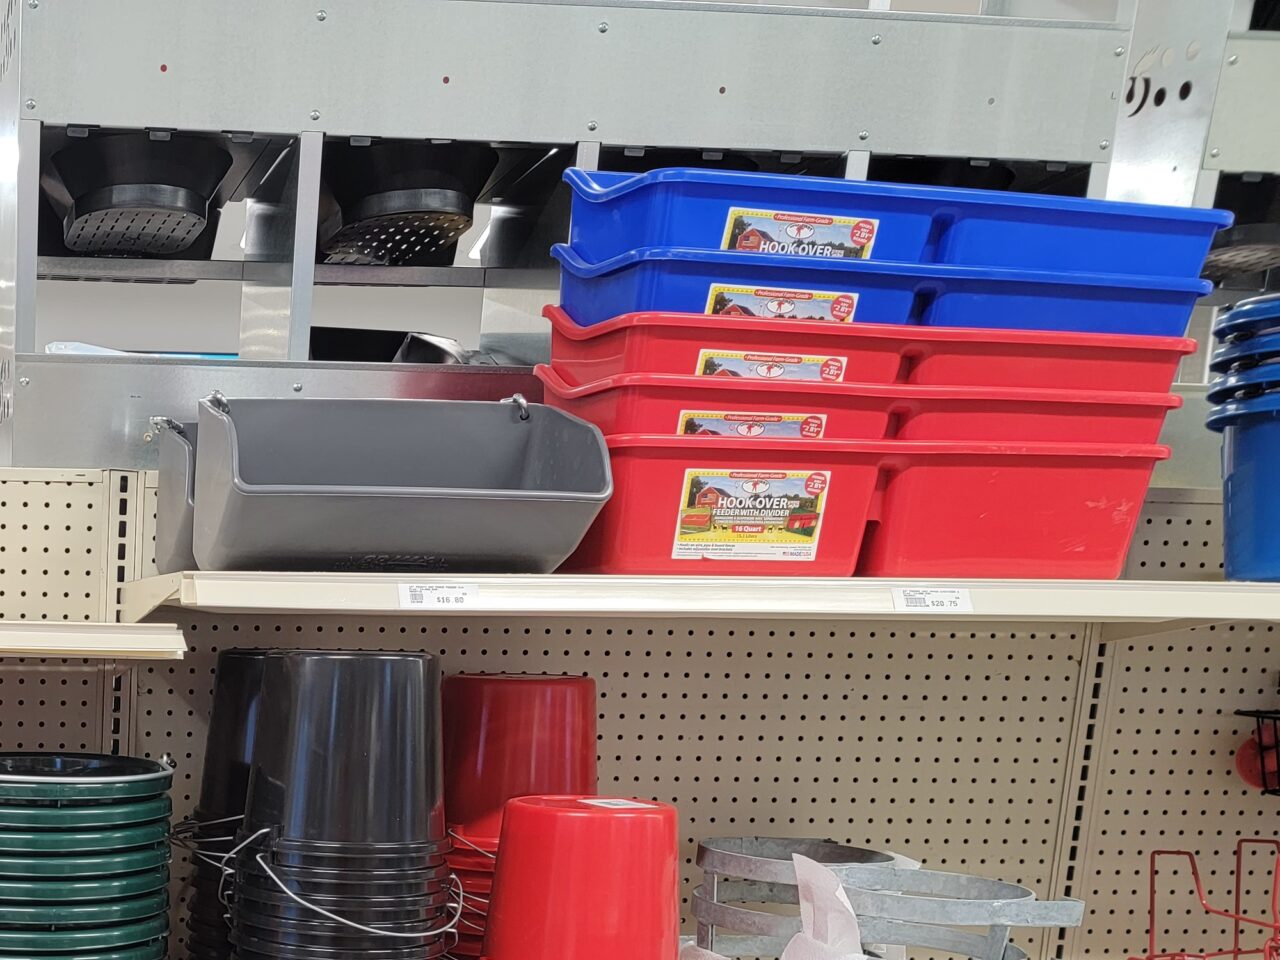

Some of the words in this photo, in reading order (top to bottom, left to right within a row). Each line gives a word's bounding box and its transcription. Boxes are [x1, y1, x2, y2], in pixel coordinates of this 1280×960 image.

[759, 241, 795, 254] HOOK
[796, 243, 832, 257] OVER
[718, 497, 755, 508] HOOK
[756, 497, 788, 509] OVER
